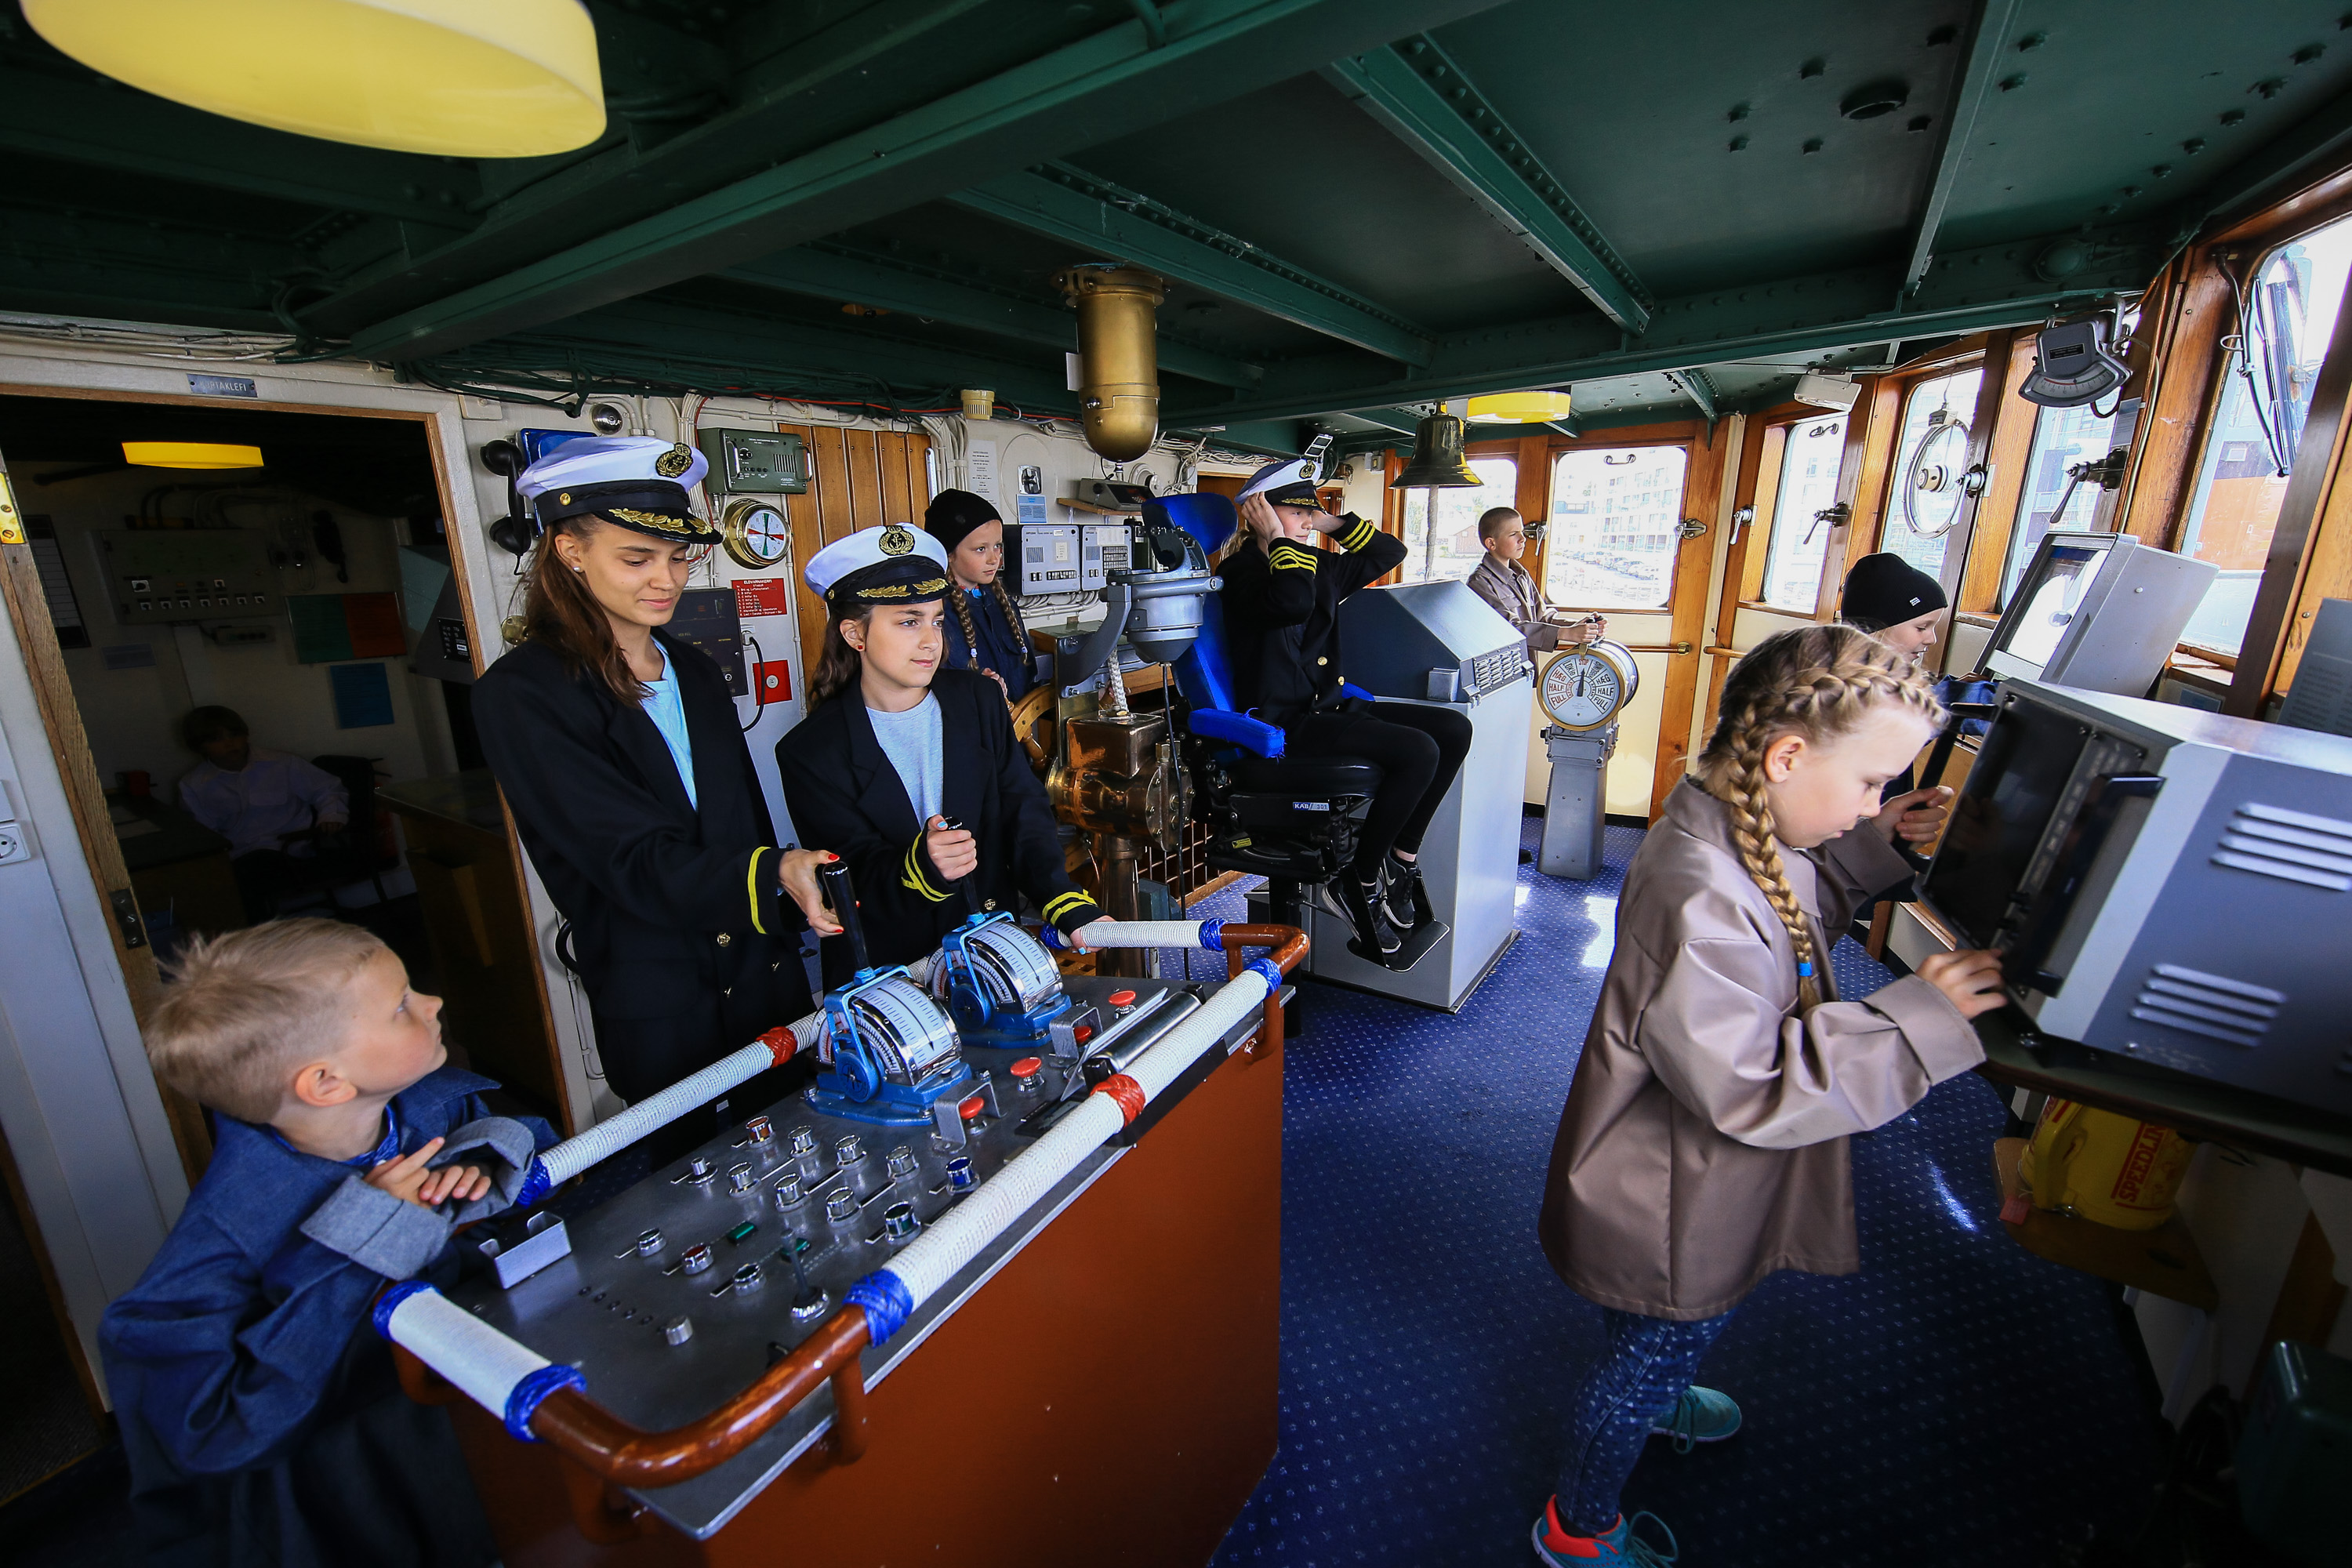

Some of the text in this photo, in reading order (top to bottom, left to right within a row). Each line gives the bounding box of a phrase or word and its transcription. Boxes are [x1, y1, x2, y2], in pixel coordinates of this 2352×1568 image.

[1552, 670, 1567, 682] HÆG
[1596, 674, 1611, 685] HÆG
[1549, 683, 1564, 692] HALF
[1597, 687, 1614, 697] HALF
[1551, 695, 1567, 706] FULL
[1593, 697, 1609, 711] FULL
